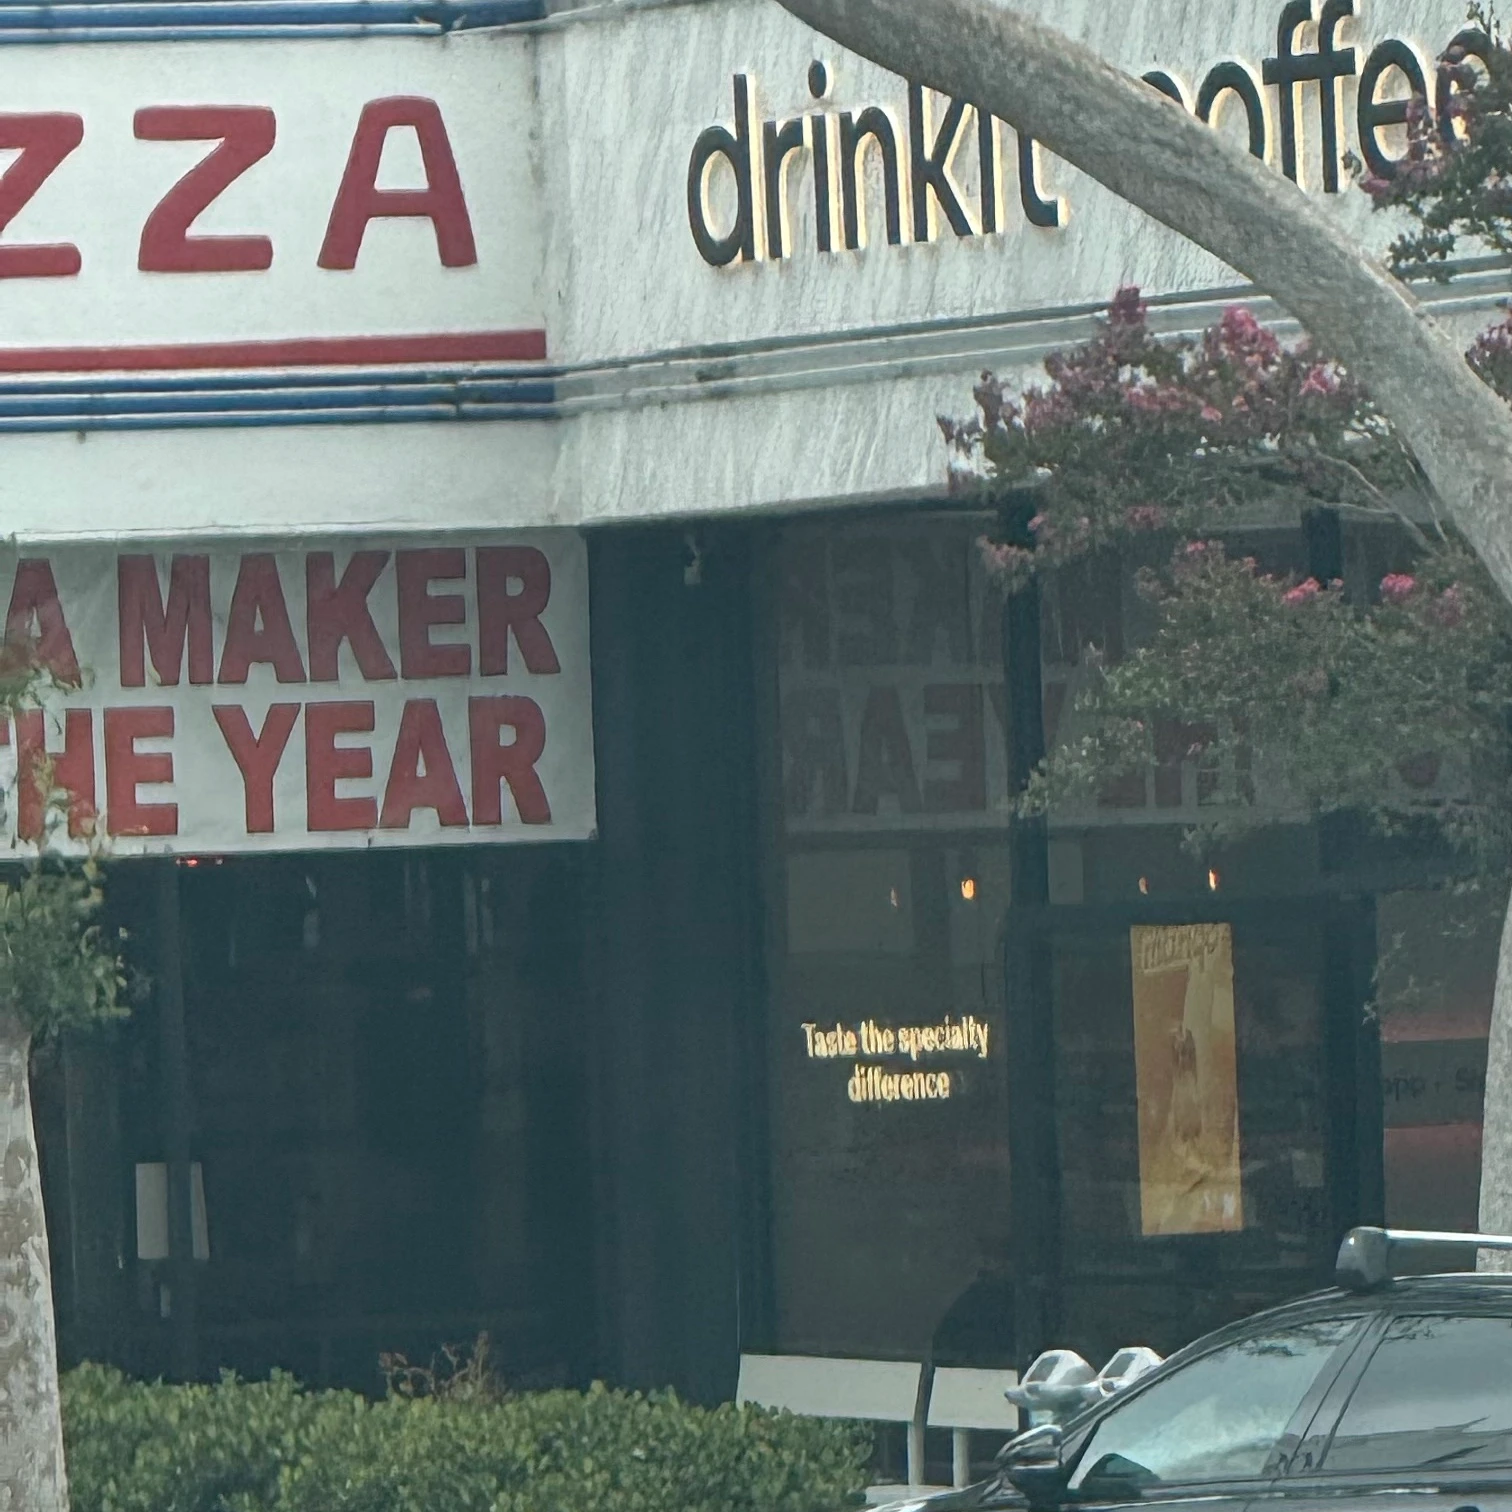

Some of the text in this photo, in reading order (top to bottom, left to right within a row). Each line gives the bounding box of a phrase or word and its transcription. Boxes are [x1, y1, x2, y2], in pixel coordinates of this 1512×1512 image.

[1141, 0, 1494, 193] offe
[0, 95, 477, 278] ZZA
[117, 546, 561, 687] MAKER
[0, 695, 552, 840] HE YEAR
[800, 1014, 989, 1062] Taste the specialty
[847, 1062, 951, 1103] difference
